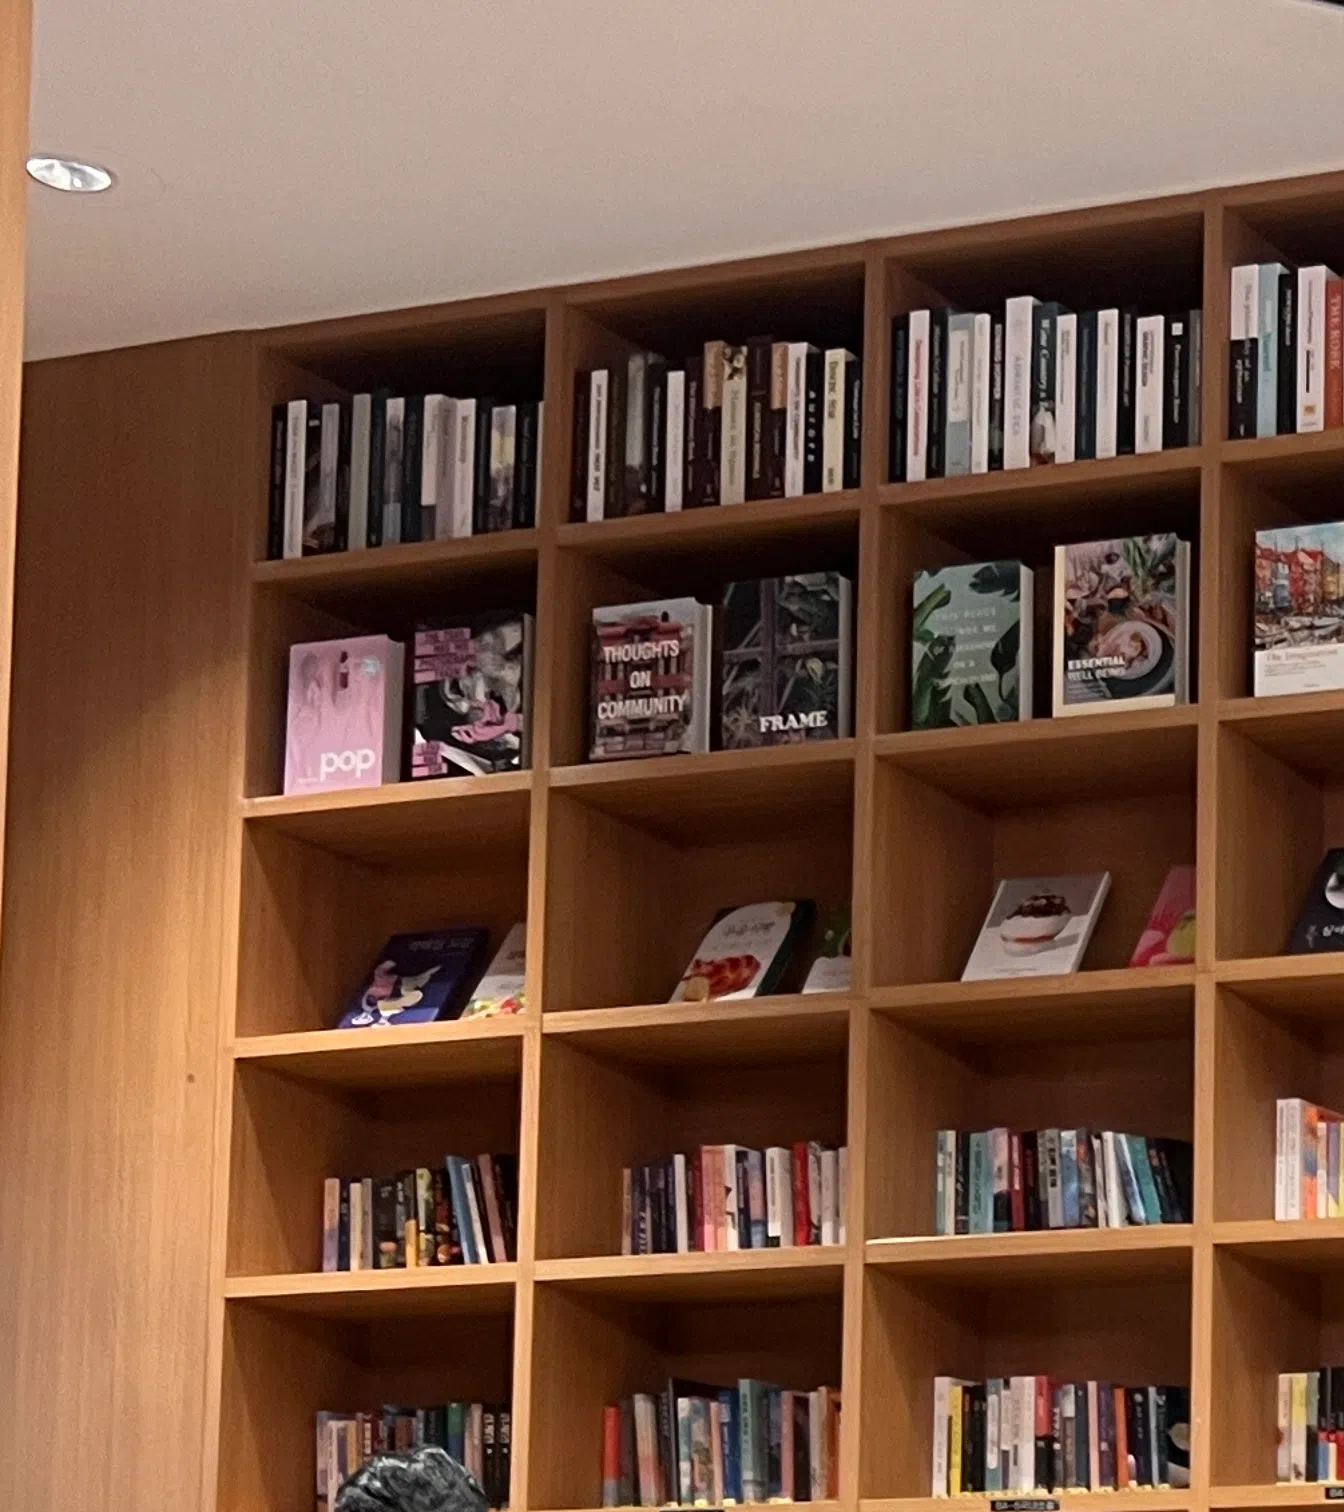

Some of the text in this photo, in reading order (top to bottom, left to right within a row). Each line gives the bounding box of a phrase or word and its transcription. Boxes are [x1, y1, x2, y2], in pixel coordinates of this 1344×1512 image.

[603, 640, 679, 663] THOUGHTS
[1067, 656, 1125, 670] ESSENTIAL
[630, 671, 651, 688] ON
[598, 694, 688, 719] COMMUNITY
[759, 711, 828, 733] FRAME
[320, 748, 376, 783] pop
